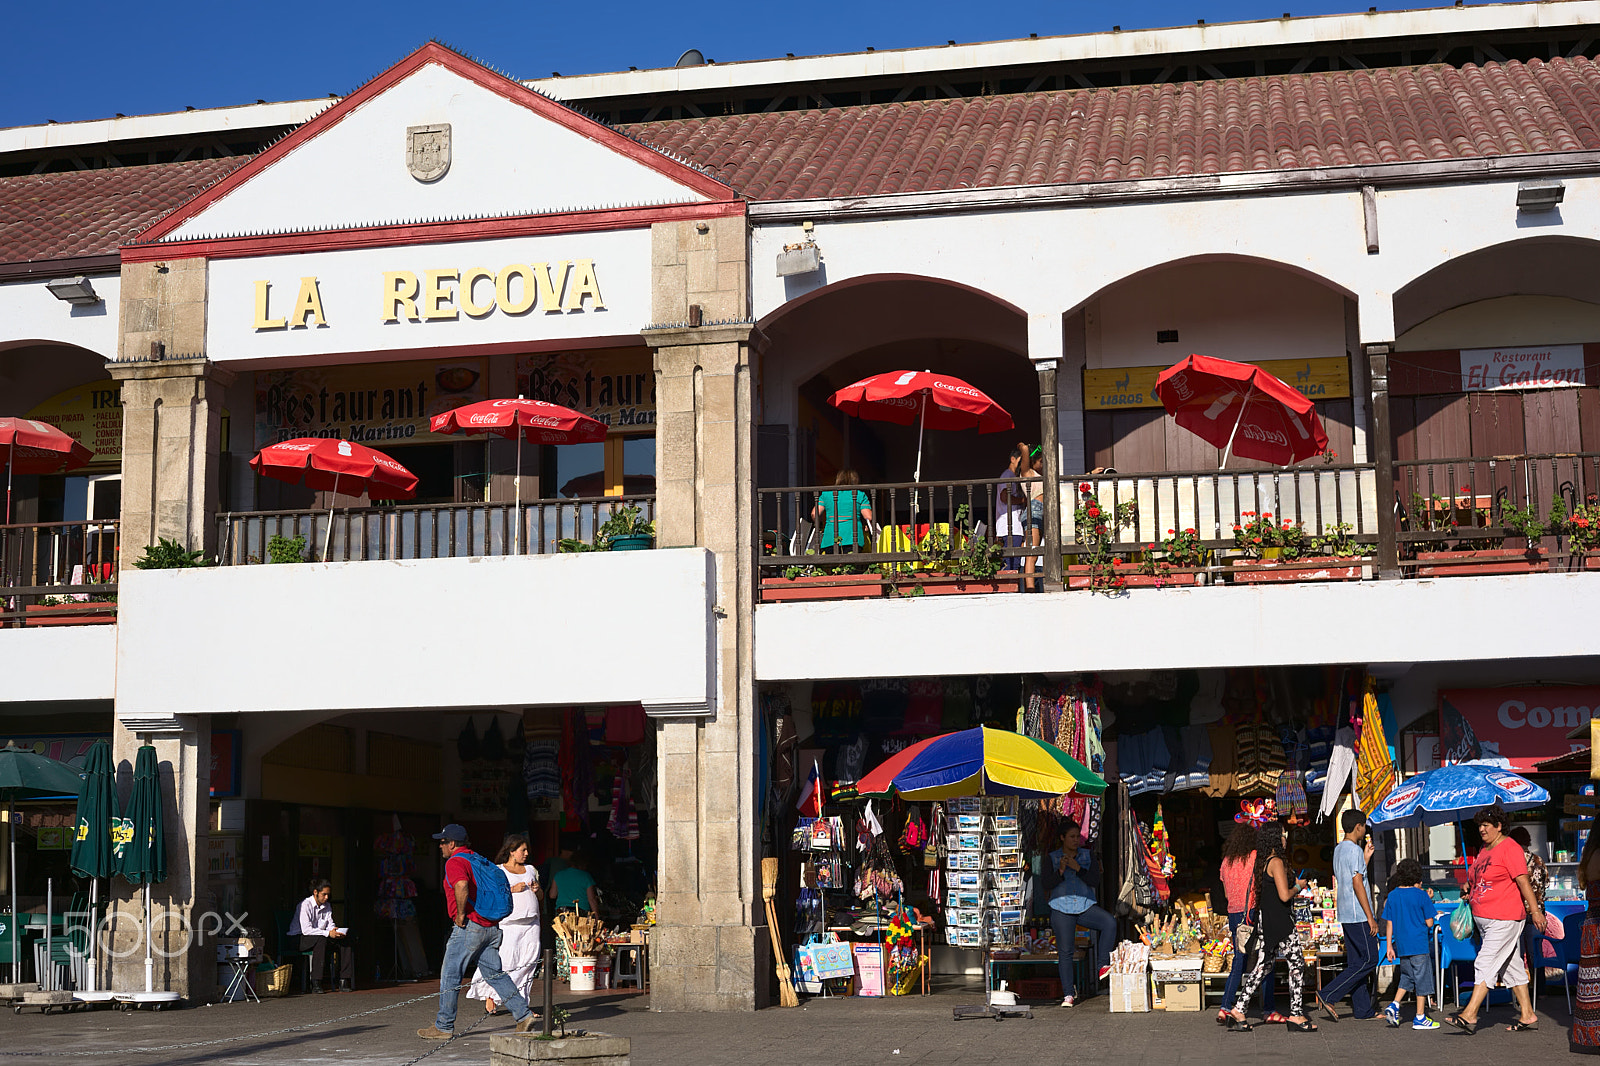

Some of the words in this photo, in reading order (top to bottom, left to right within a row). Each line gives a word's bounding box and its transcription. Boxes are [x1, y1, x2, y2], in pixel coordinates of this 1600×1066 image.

[252, 276, 327, 329] LA
[381, 258, 606, 322] RECOVA
[1493, 351, 1552, 363] Restorant
[1467, 363, 1489, 388] El
[1498, 361, 1580, 387] Galeon
[266, 380, 429, 426] Restaurant
[1100, 392, 1143, 406] LIBROS
[62, 413, 85, 422] PIRATA
[96, 411, 120, 420] PAELLA
[349, 421, 417, 442] Marino
[95, 437, 117, 446] CHUPE
[1385, 788, 1419, 808] Savory
